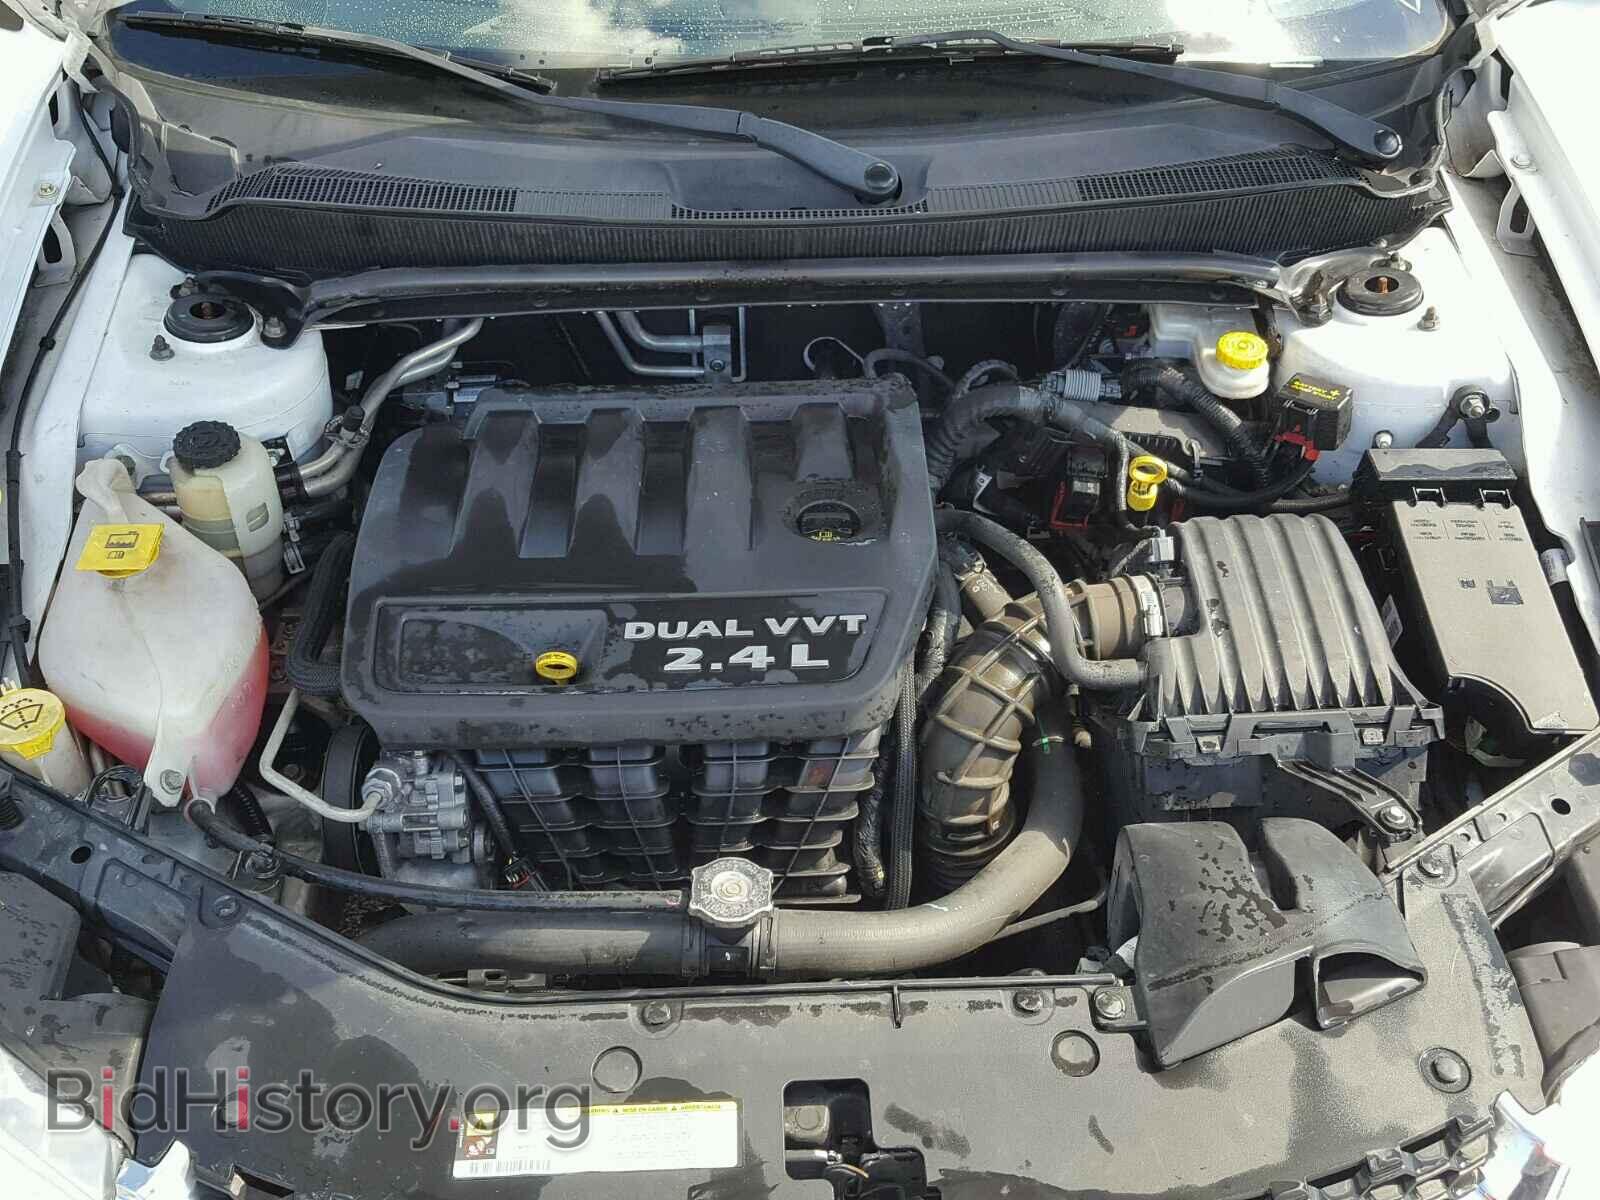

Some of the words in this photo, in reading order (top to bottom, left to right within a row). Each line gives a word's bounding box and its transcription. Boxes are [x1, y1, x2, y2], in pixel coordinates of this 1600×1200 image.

[624, 619, 754, 640] DUAL
[764, 614, 867, 636] VVT
[663, 645, 776, 671] 2.4
[790, 643, 830, 669] L
